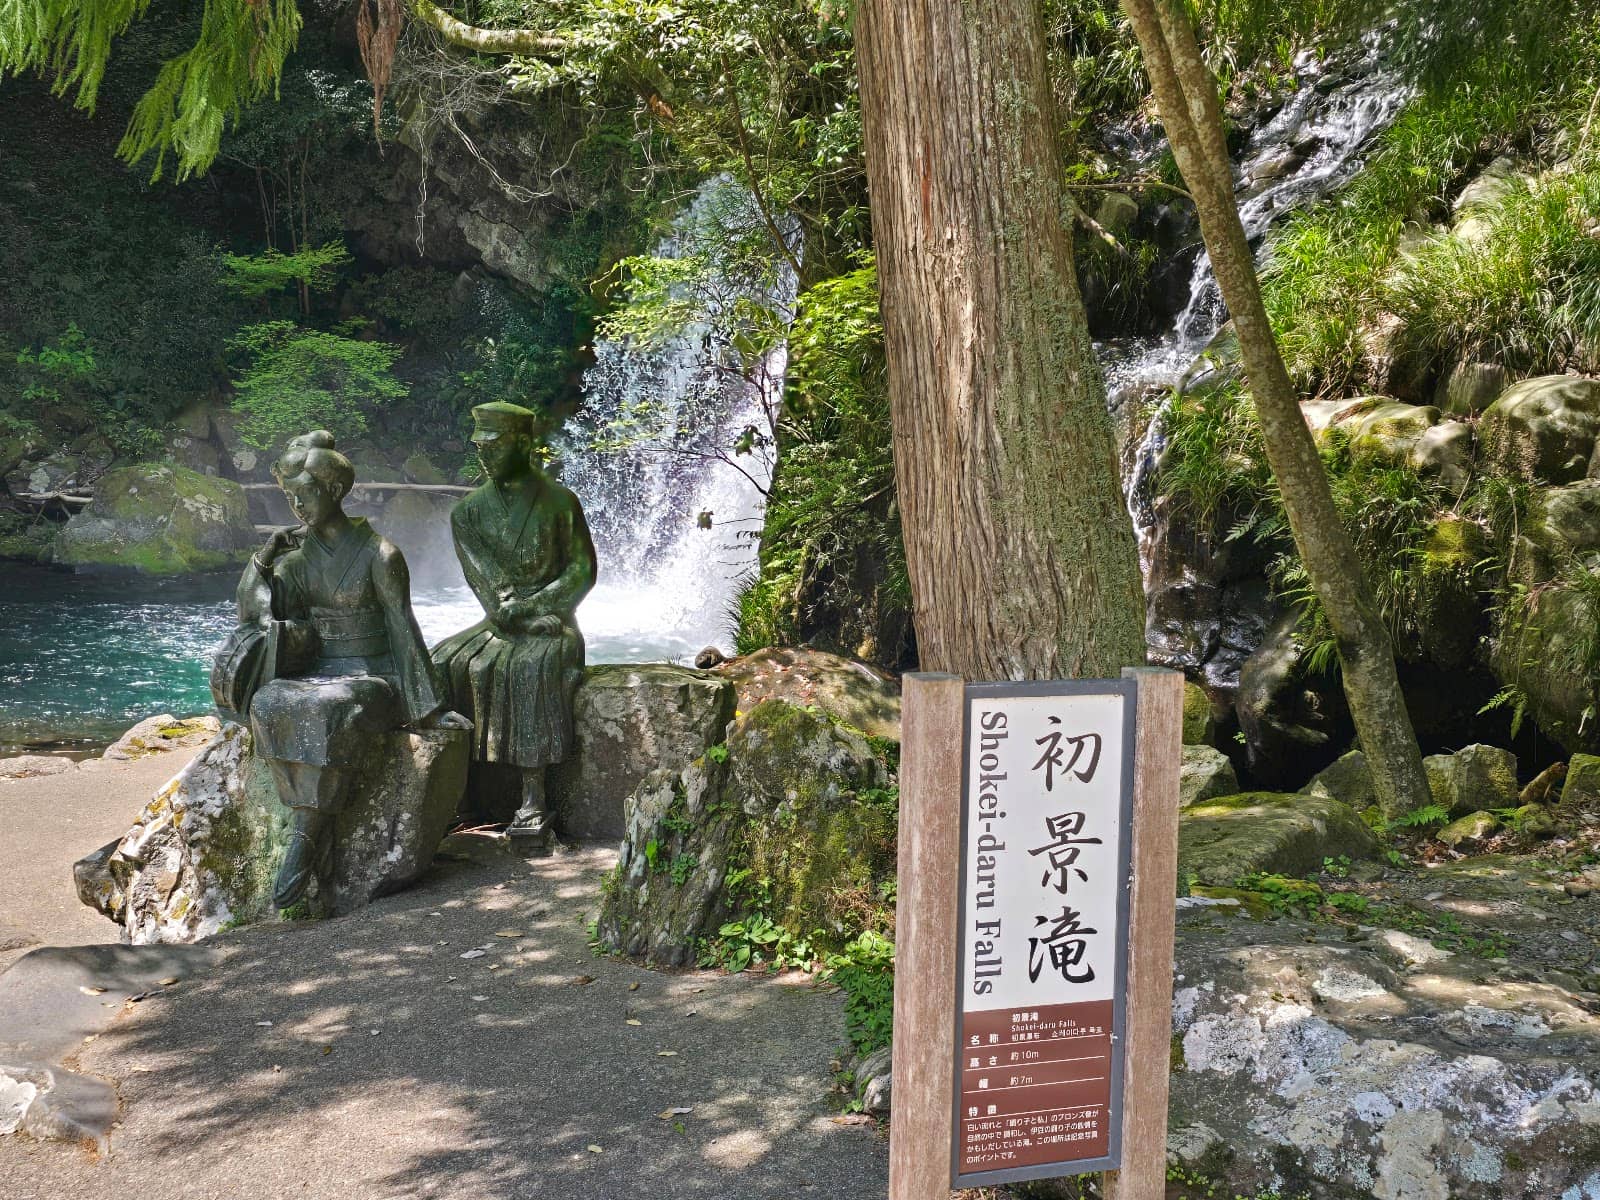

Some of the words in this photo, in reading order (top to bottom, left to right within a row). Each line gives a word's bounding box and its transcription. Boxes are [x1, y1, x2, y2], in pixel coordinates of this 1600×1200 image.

[975, 711, 1008, 911] Shokei-daru
[1027, 715, 1104, 984] 初景滝
[973, 918, 1002, 995] Falls
[970, 1055, 998, 1068] 高さ
[1059, 1019, 1076, 1028] Falls
